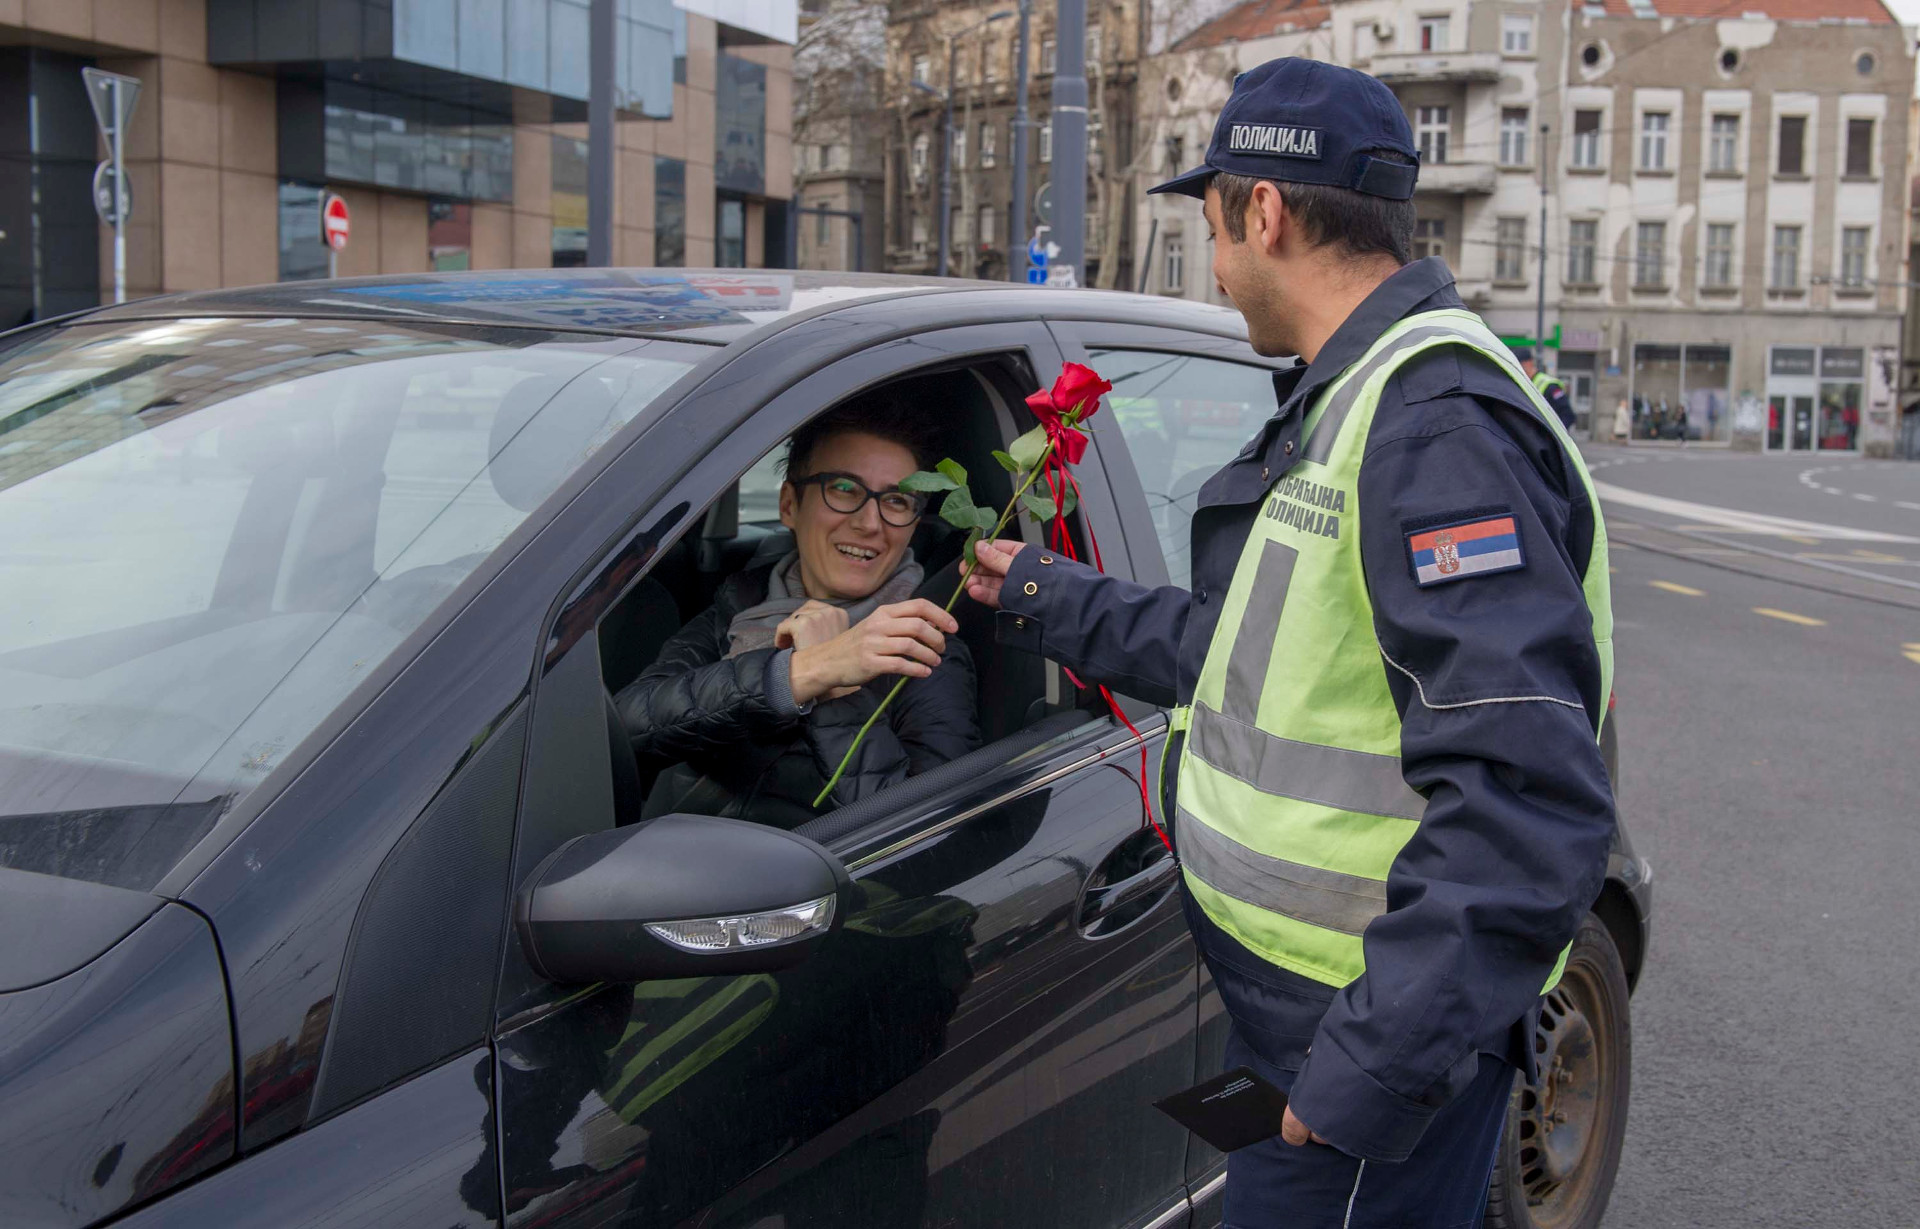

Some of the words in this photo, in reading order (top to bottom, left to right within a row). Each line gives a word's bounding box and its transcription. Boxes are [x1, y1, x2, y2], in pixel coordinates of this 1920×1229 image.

[1230, 125, 1317, 155] ПОЛИЦИЈА
[1274, 475, 1345, 513] ОБРАЋАЈНА
[1266, 497, 1339, 539] ОЛИЦИЈА
